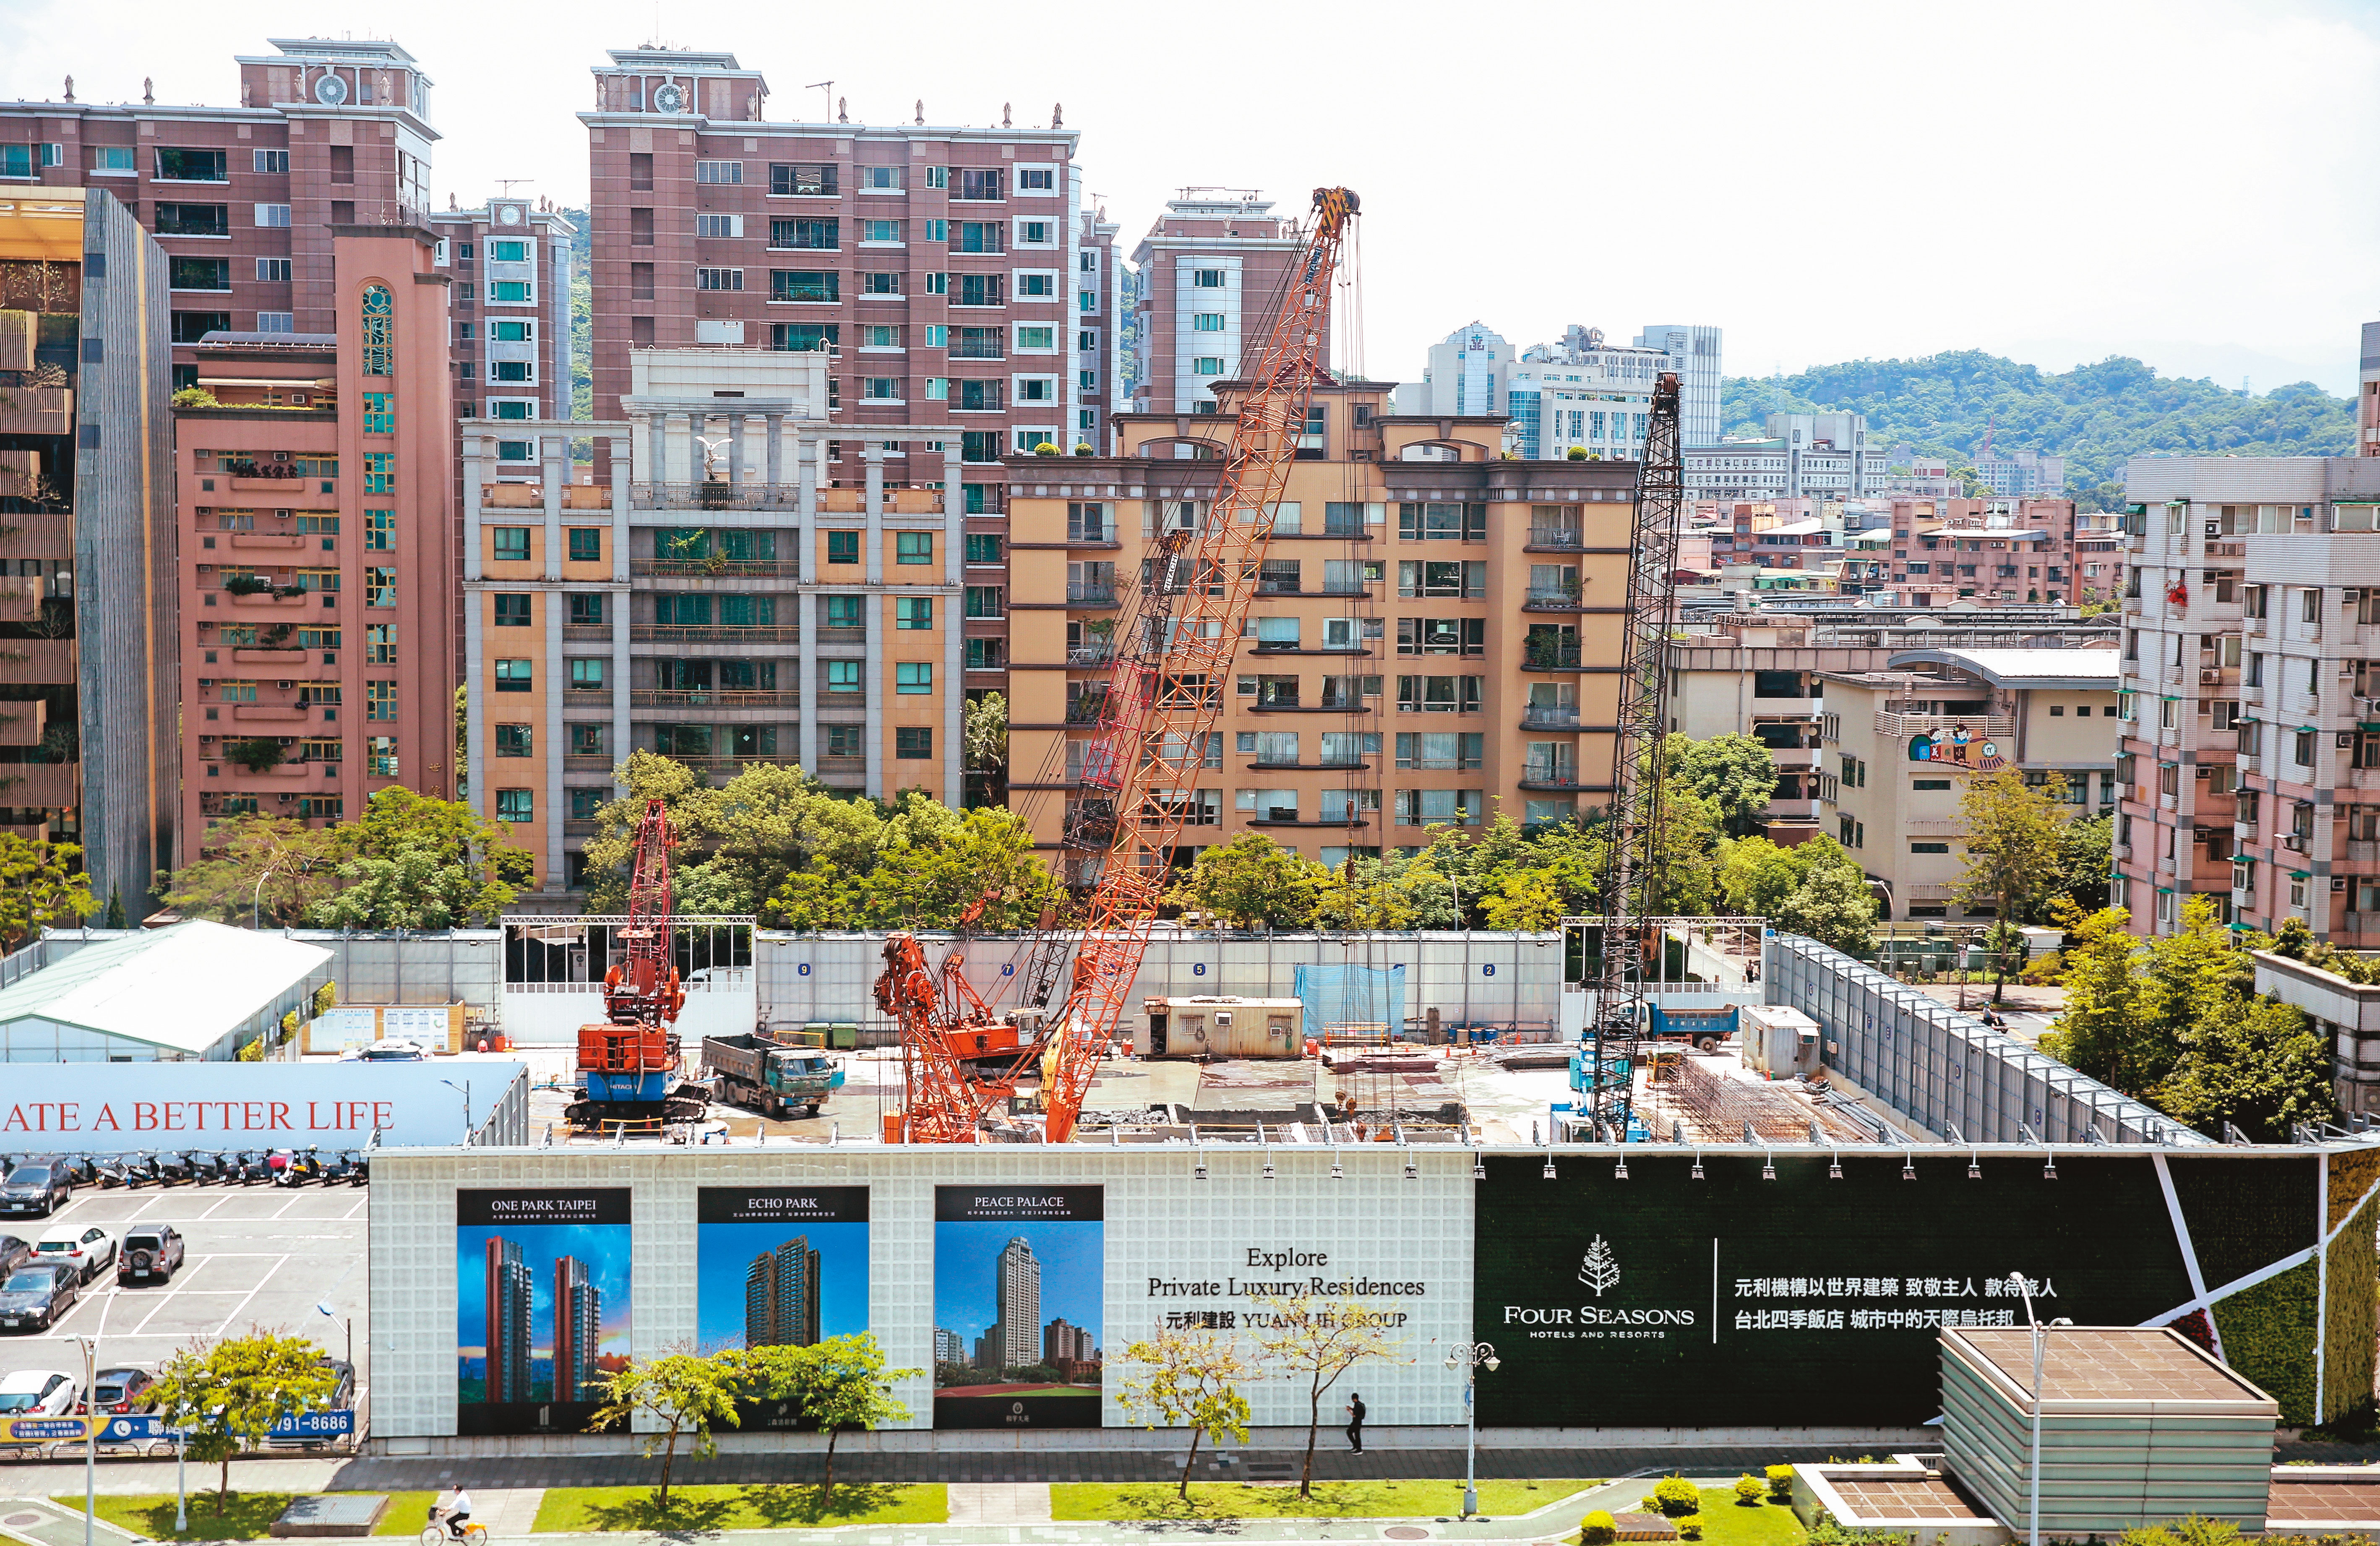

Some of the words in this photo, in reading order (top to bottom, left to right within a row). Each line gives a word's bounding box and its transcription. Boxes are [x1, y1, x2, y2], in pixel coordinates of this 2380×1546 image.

[1305, 247, 1322, 284] HITACHI
[1165, 554, 1178, 590] HITACHI
[801, 965, 807, 974] 9
[1197, 965, 1202, 974] 5
[1486, 966, 1492, 975] 2
[93, 1103, 121, 1131] A
[135, 1102, 295, 1131] BETTER
[308, 1102, 395, 1130] LIFE
[492, 1200, 519, 1211] ONE
[521, 1200, 555, 1211] PARK
[556, 1200, 596, 1210] TAIPEI
[748, 1198, 783, 1209] ECHO
[785, 1198, 818, 1208] PARK
[975, 1197, 1014, 1207] PEACE
[1017, 1197, 1064, 1207] PALACE
[1247, 1247, 1328, 1272] Explore
[1148, 1277, 1220, 1296] Private
[1228, 1277, 1303, 1300] Luxury
[1310, 1277, 1425, 1296] Residences
[1734, 1277, 1899, 1297] 元利機構以世界建築
[1905, 1277, 1978, 1297] 致敬主人
[1984, 1277, 2057, 1298] 款待旅人
[1165, 1311, 1236, 1331] 元利建設
[1242, 1313, 1298, 1327] YUAN
[1503, 1306, 1574, 1324] FOUR
[1580, 1306, 1694, 1325] SEASONS
[1734, 1309, 1845, 1329] 台北四季飯店
[1849, 1309, 2015, 1329] 城市中的天際烏托邦
